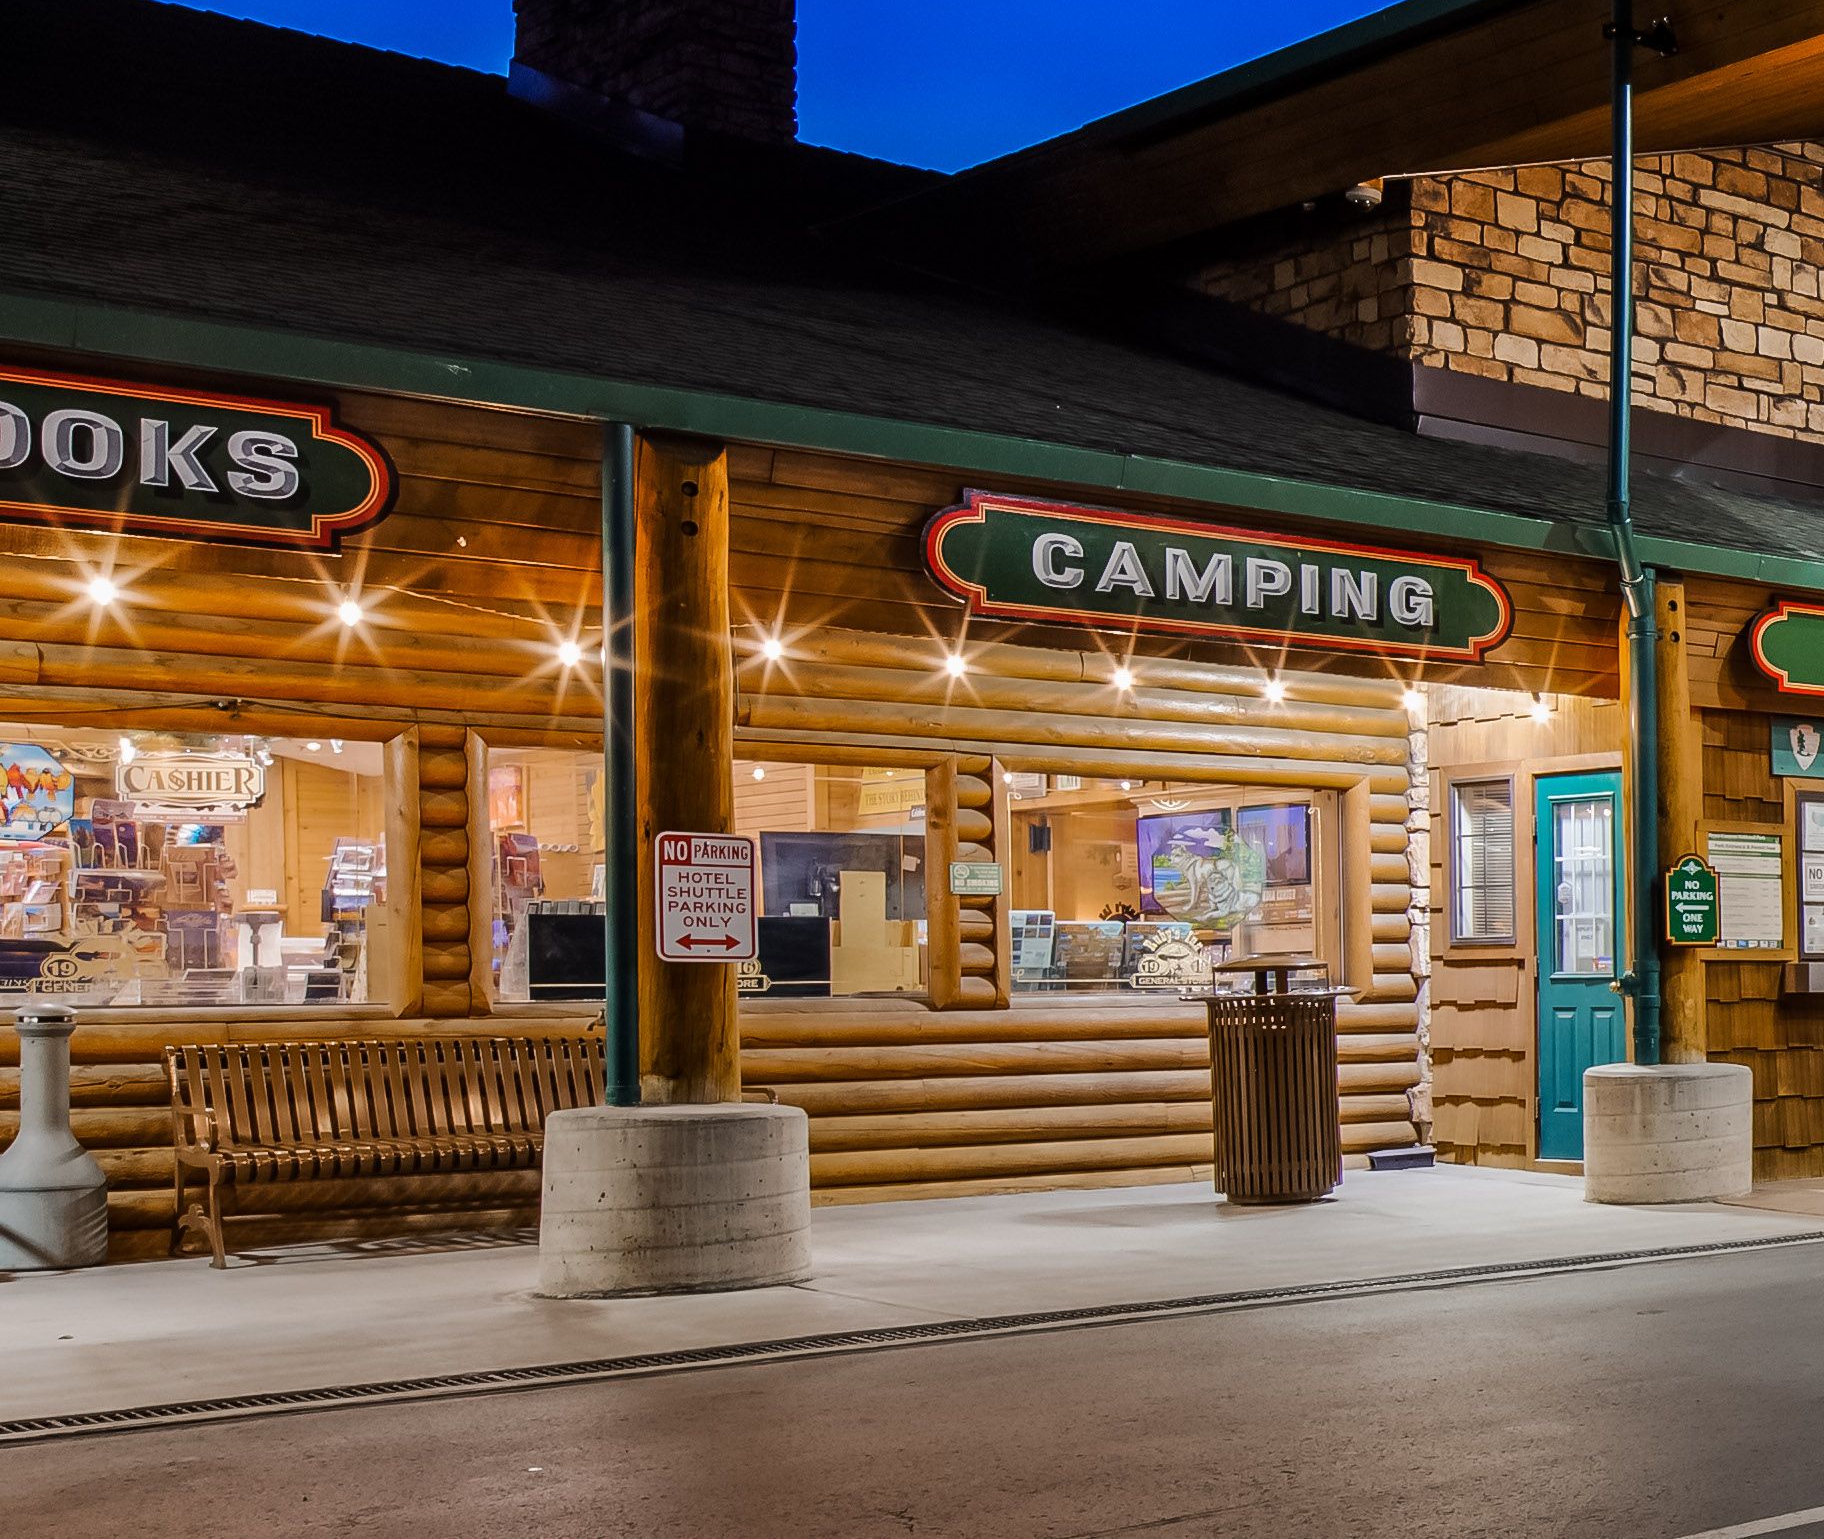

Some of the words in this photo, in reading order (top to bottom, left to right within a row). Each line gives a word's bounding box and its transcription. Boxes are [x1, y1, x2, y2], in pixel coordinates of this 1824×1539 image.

[1032, 532, 1434, 626] CAMPING
[124, 765, 256, 794] CASHIER
[663, 840, 688, 861] NO
[694, 844, 749, 861] PARKING
[678, 871, 736, 885] HOTEL
[1809, 868, 1823, 880] NO
[1684, 880, 1700, 890] NO
[667, 886, 747, 900] SHUTTLE
[1671, 891, 1714, 901] PARKING
[668, 901, 747, 914] PARKING
[683, 916, 732, 928] ONLY
[1682, 913, 1704, 923] ONE
[1682, 924, 1704, 934] WAY
[49, 962, 72, 977] 19
[1142, 961, 1159, 974] 19
